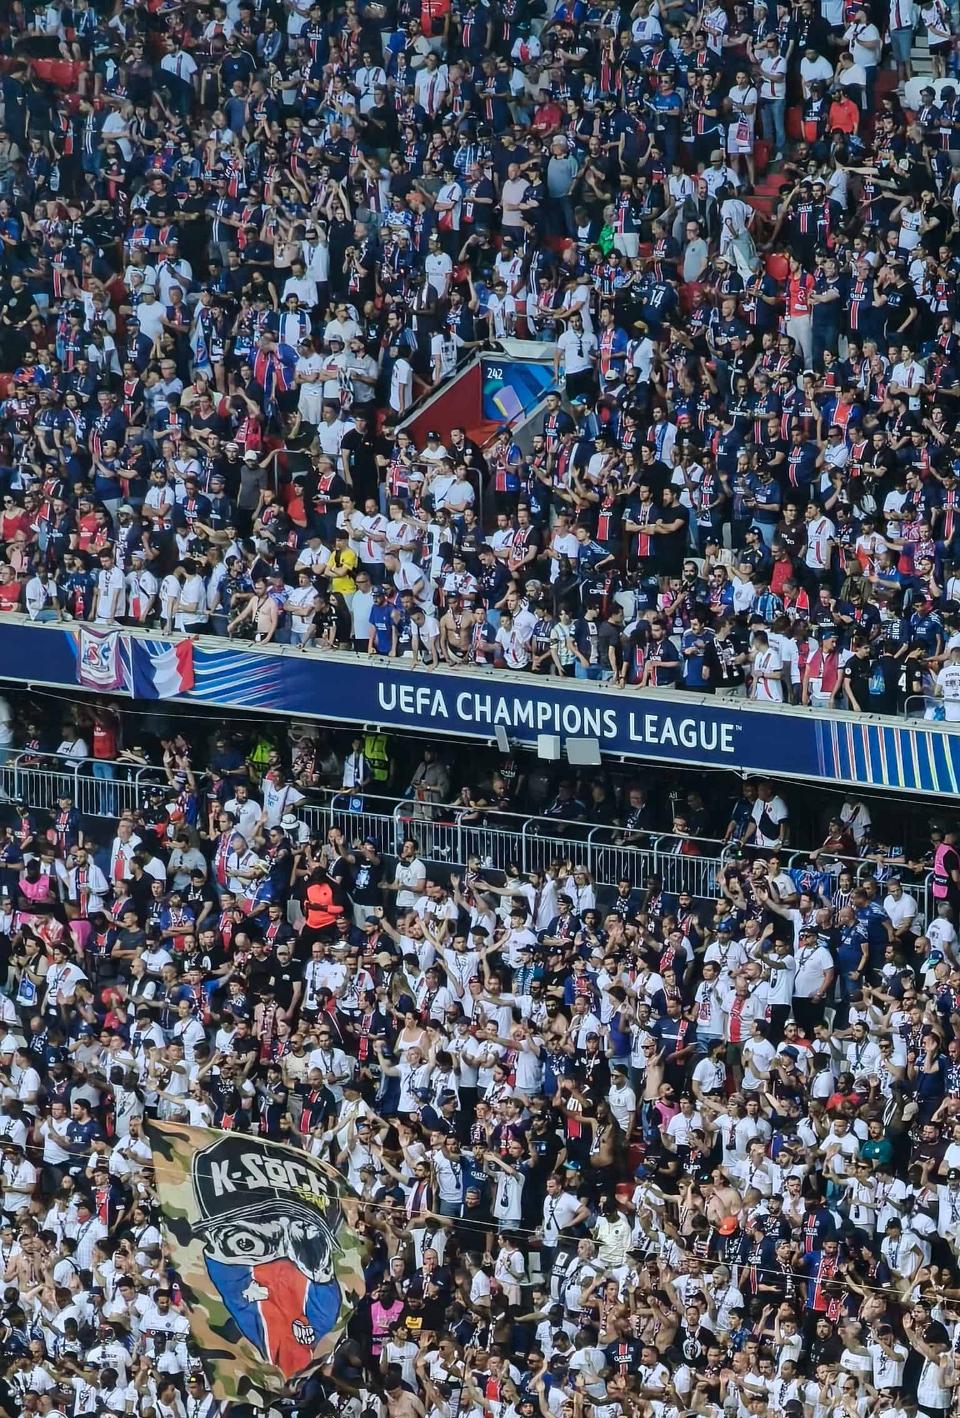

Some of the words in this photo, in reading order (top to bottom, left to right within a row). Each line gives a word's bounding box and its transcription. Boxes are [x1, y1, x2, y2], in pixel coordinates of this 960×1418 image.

[650, 291, 664, 308] 14
[487, 368, 503, 380] 242
[379, 682, 449, 718] UEFA
[455, 692, 618, 741] CHAMPIONS
